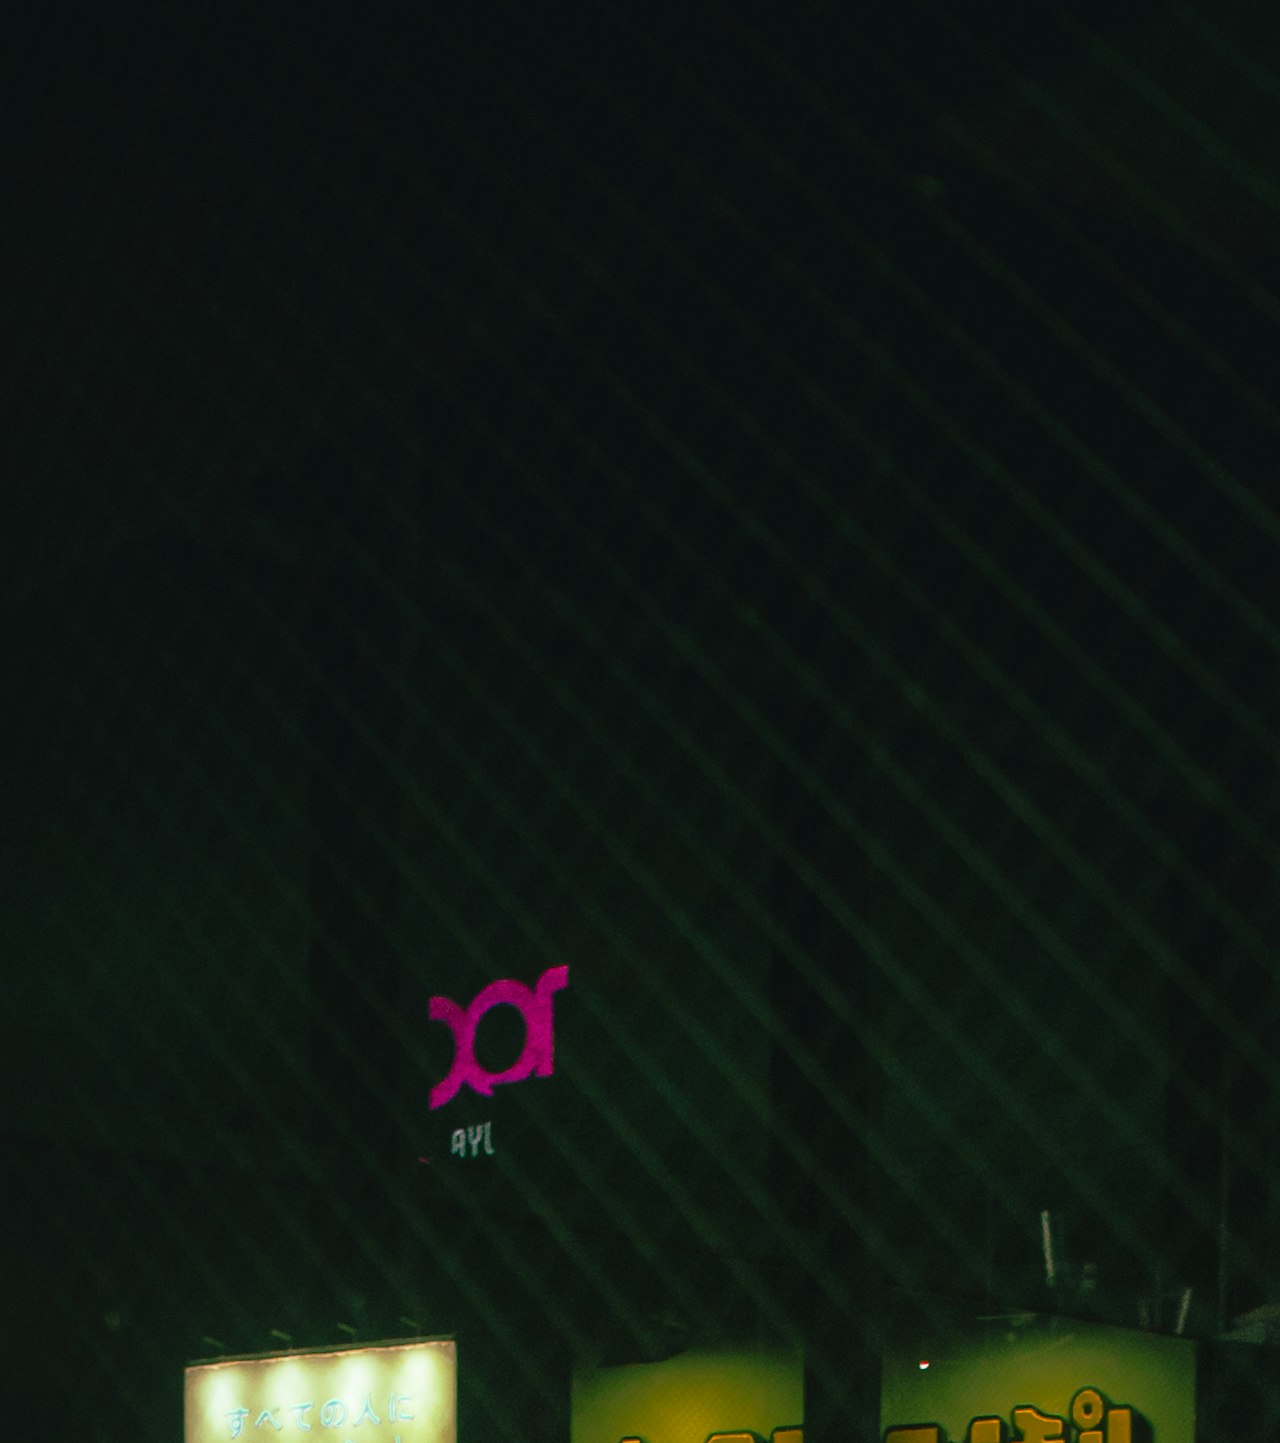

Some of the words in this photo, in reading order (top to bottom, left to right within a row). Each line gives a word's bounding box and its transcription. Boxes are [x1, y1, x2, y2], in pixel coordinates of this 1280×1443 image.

[224, 1393, 416, 1439] すべての人に
